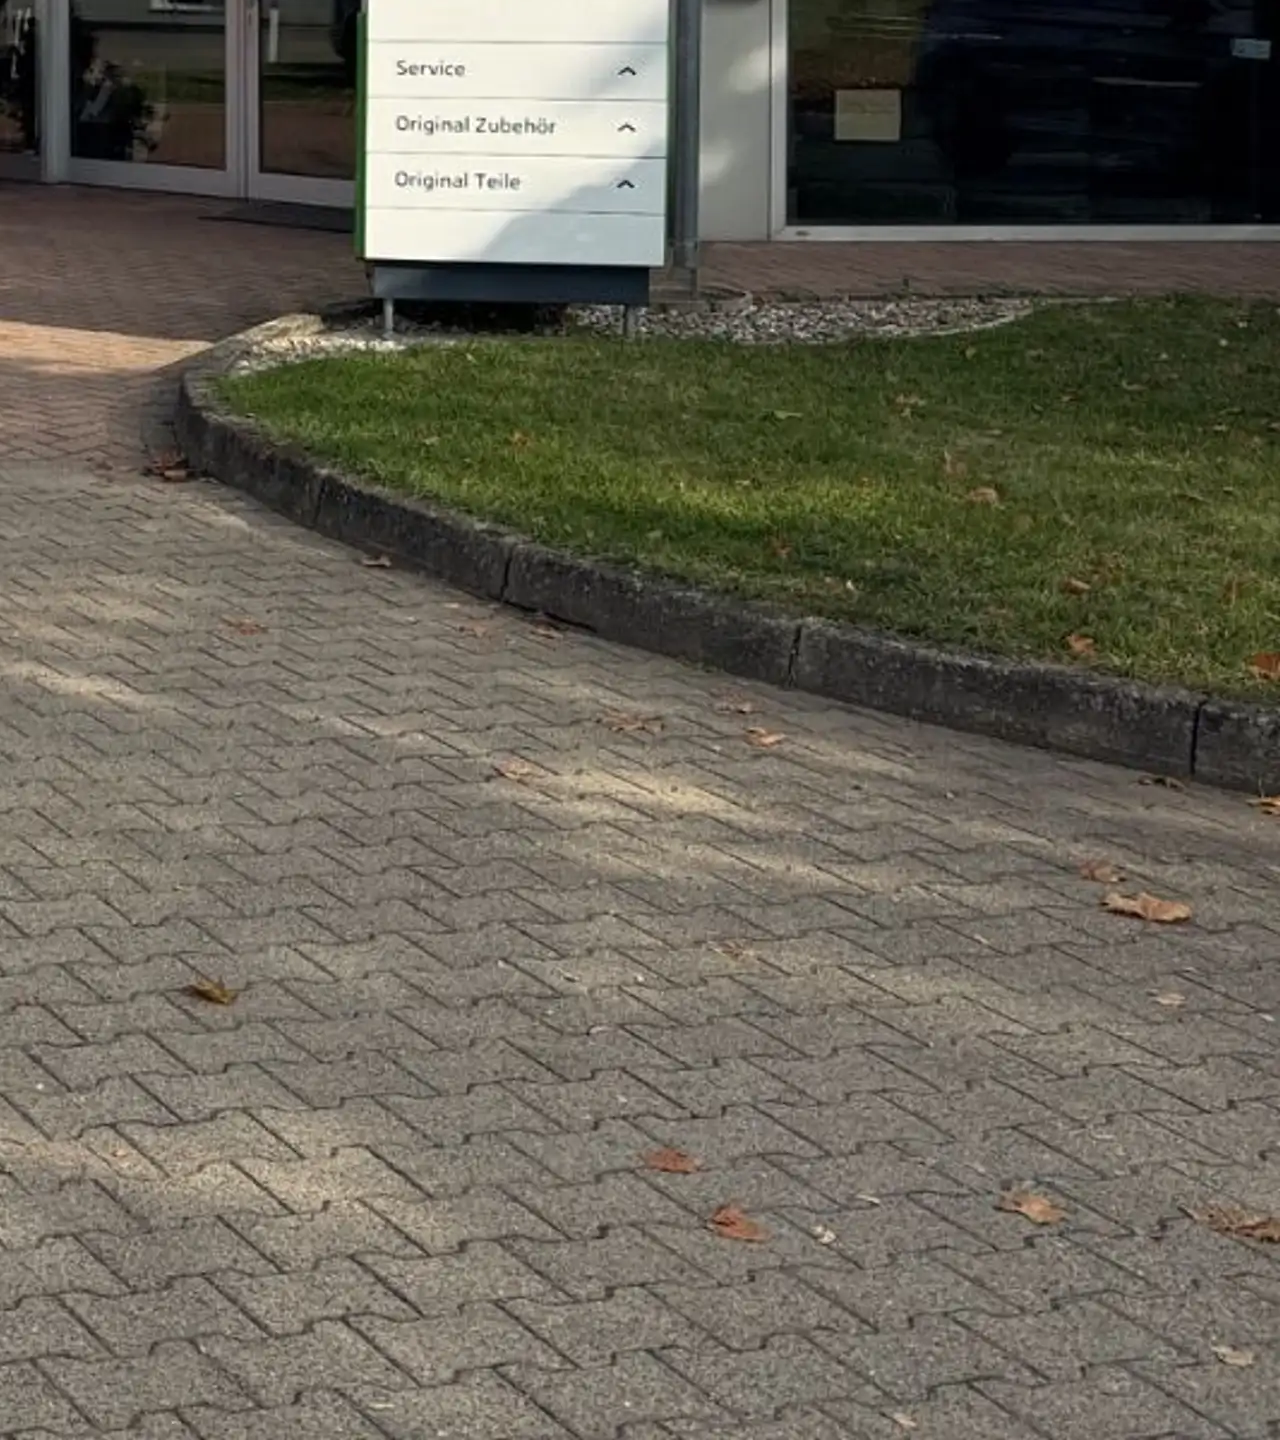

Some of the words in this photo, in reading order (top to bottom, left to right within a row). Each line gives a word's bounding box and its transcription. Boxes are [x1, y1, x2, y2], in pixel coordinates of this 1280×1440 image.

[396, 60, 466, 77] Service
[395, 115, 471, 136] Original
[475, 116, 557, 135] Zubehör
[394, 171, 468, 191] Original
[474, 172, 522, 191] Teile
